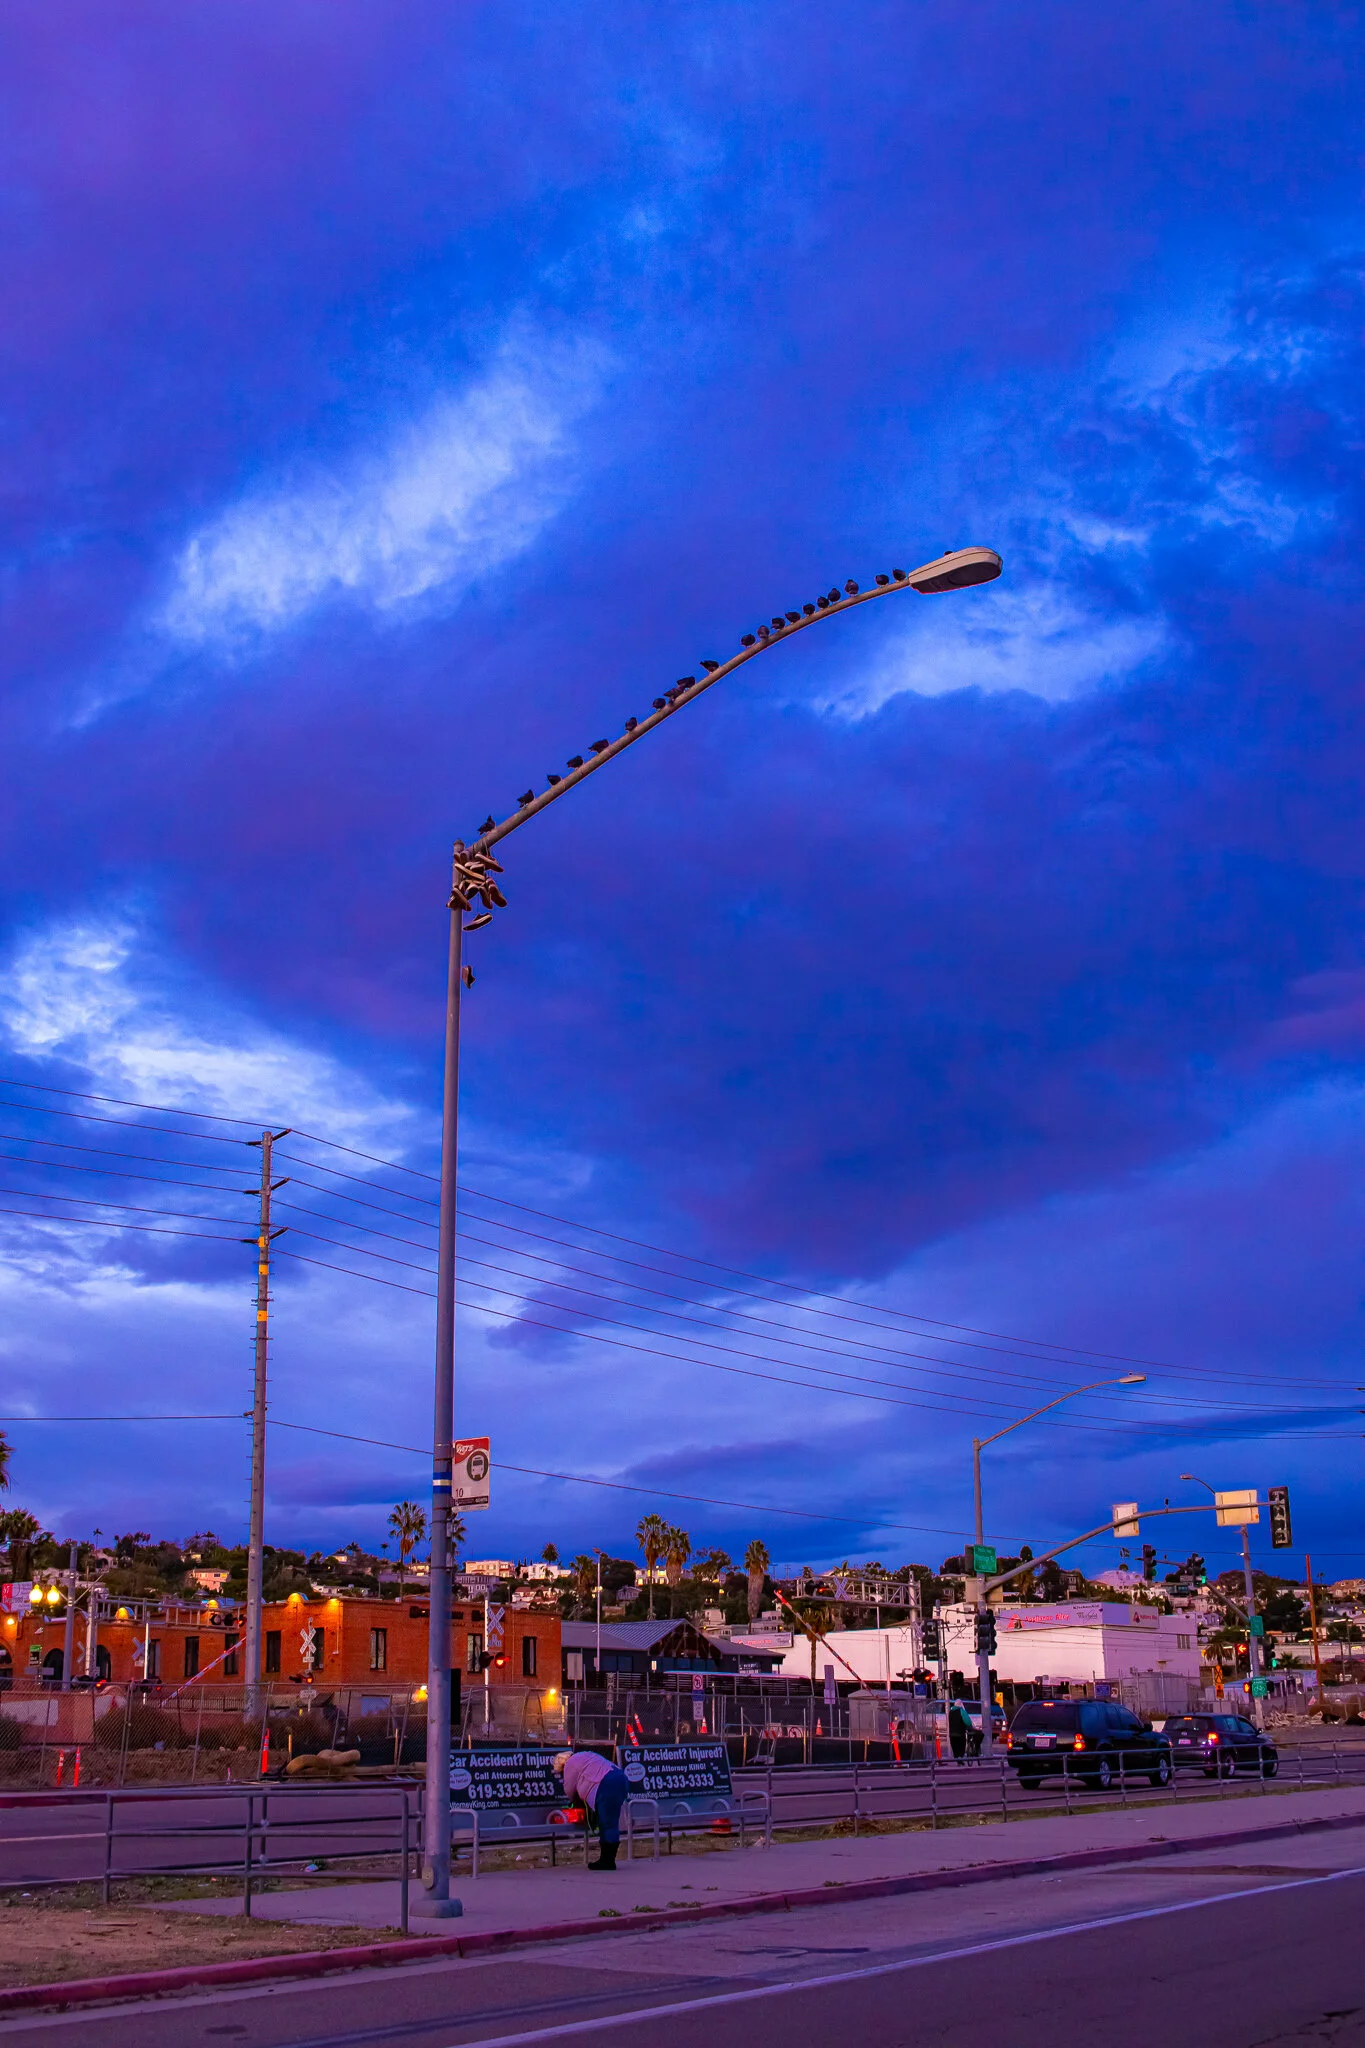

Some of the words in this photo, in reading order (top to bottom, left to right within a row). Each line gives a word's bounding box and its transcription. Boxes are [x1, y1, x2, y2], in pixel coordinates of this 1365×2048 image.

[455, 1488, 463, 1497] 10
[624, 1750, 641, 1762] Car
[643, 1747, 687, 1761] Accident?
[689, 1746, 723, 1761] Injured?
[469, 1754, 523, 1768] Accident?
[526, 1753, 555, 1769] Injure
[647, 1765, 660, 1773] Call
[661, 1764, 688, 1773] Attorney
[689, 1763, 706, 1771] KING!
[474, 1772, 489, 1780] Call
[491, 1771, 523, 1781] Attorney
[525, 1770, 546, 1779] KING!
[643, 1773, 714, 1790] 619-333-3333
[468, 1782, 555, 1799] 619-333-3333
[627, 1791, 669, 1800] AttorneyKing.com
